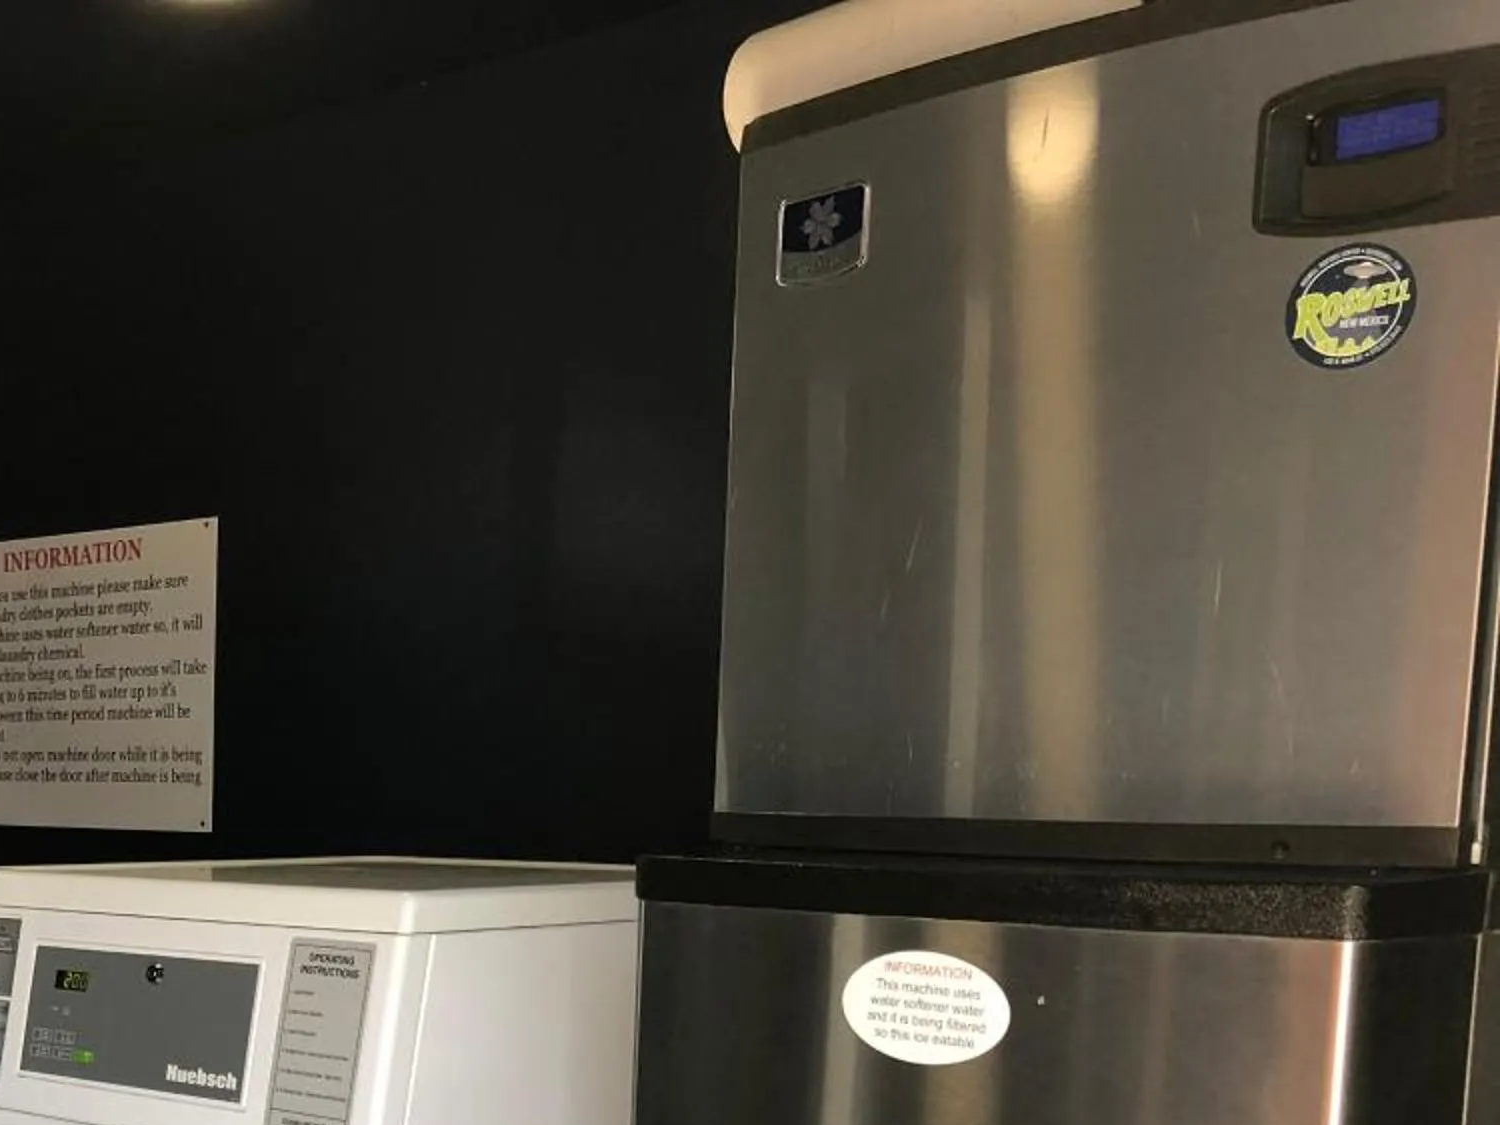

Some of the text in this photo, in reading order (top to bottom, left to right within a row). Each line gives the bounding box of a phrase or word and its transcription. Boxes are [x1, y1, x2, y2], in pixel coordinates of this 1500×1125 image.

[1293, 278, 1411, 339] ROSWELL
[3, 538, 143, 572] INFORMATION
[12, 592, 28, 603] use
[30, 586, 49, 599] this
[51, 582, 95, 599] machine
[97, 579, 130, 598] please
[133, 574, 162, 591] make
[165, 574, 188, 589] sure
[19, 605, 54, 621] clothes
[56, 603, 95, 621] pockets
[98, 603, 114, 616] are
[22, 631, 43, 641] uses
[46, 626, 73, 640] water
[76, 623, 118, 639] softener
[121, 623, 151, 635] water
[172, 616, 180, 630] it
[183, 614, 203, 631] will
[0, 647, 35, 664] laundry
[28, 668, 55, 684] being
[76, 666, 92, 679] the
[96, 663, 116, 680] first
[119, 663, 159, 682] process
[161, 660, 181, 674] will
[183, 658, 207, 674] take
[28, 687, 67, 701] minutes
[70, 686, 80, 700] to
[82, 684, 96, 700] fill
[99, 687, 127, 699] water
[131, 685, 144, 702] up
[147, 684, 159, 697] to
[26, 706, 43, 721] this
[45, 707, 68, 720] time
[72, 705, 105, 725] period
[108, 705, 153, 720] machine
[155, 703, 175, 719] will
[177, 703, 191, 718] be
[21, 750, 44, 766] open
[48, 746, 89, 762] machine
[91, 747, 115, 762] door
[119, 746, 147, 762] while
[150, 748, 157, 762] it
[159, 747, 168, 761] is
[171, 746, 203, 766] being
[15, 768, 38, 782] close
[41, 767, 57, 782] the
[59, 767, 83, 782] door
[86, 768, 109, 782] after
[112, 768, 157, 783] machine
[159, 769, 168, 782] is
[171, 768, 202, 786] being
[308, 951, 355, 966] OPERATING
[299, 965, 360, 979] INSTRUCTIONS
[884, 961, 973, 981] INFORMATION
[876, 977, 981, 1001] This machine uses
[870, 994, 985, 1018] water softener water
[867, 1010, 987, 1035] and it is being filtered
[874, 1028, 888, 1039] so
[891, 1028, 911, 1041] this
[932, 1033, 975, 1050] eatable
[165, 1063, 237, 1091] Huebsch
